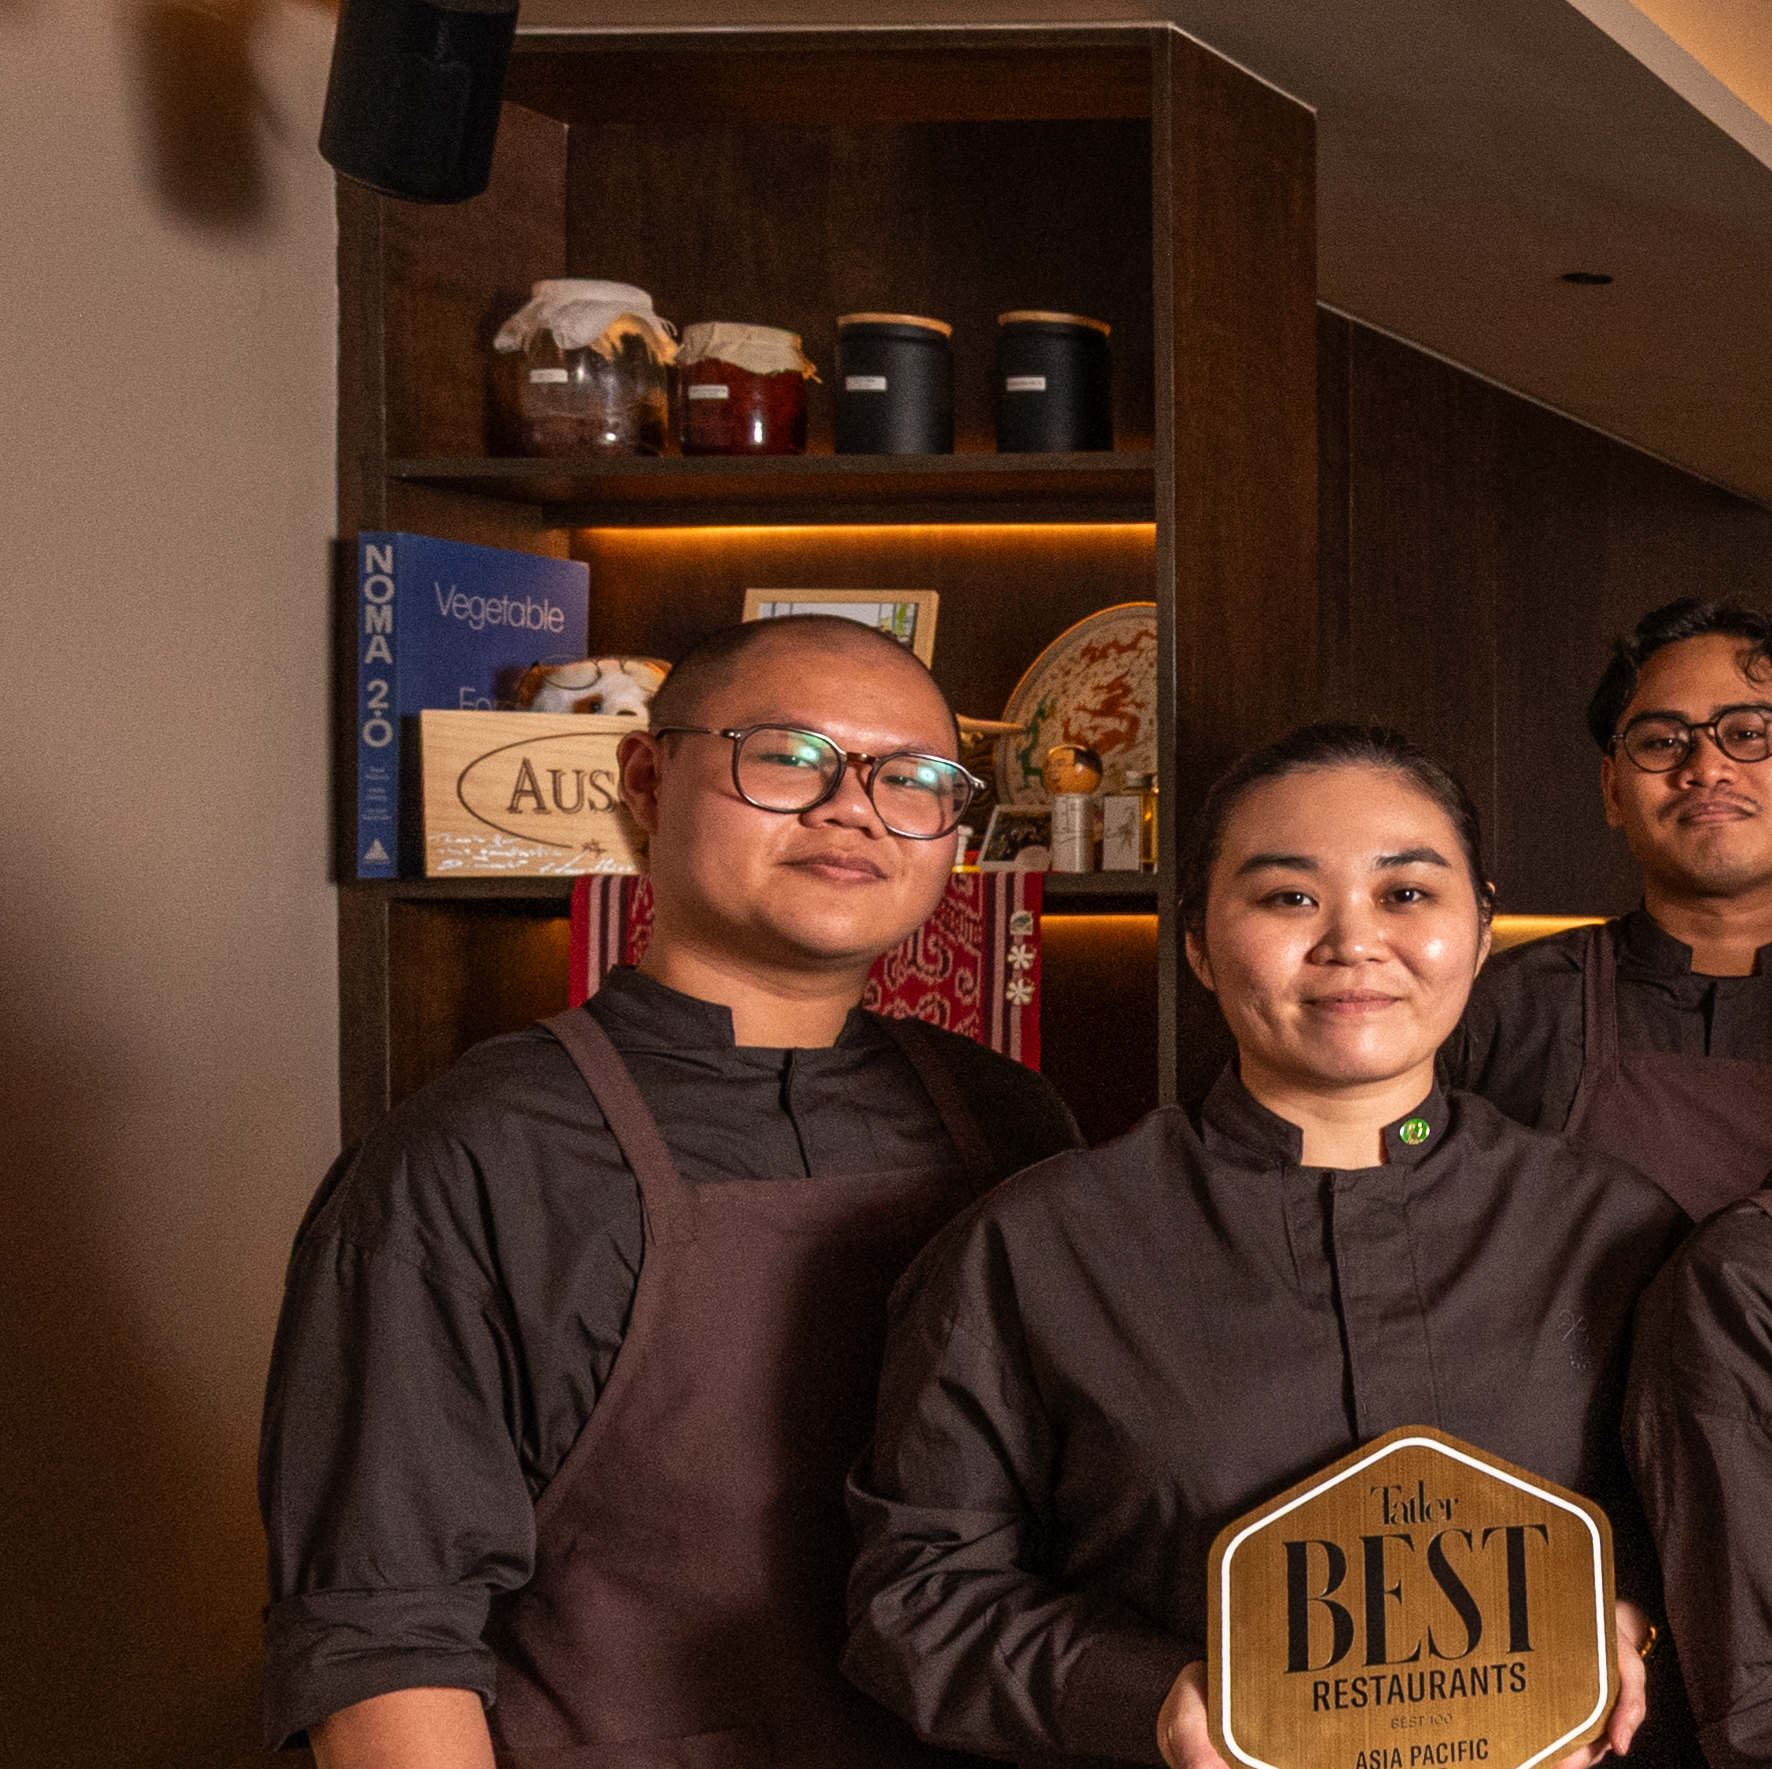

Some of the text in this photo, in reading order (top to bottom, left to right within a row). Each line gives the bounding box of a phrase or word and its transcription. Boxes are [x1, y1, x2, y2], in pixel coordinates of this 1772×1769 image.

[363, 543, 396, 665] NOMA
[434, 580, 566, 634] Vegetable
[1370, 1481, 1459, 1525] Tatler
[1281, 1523, 1549, 1674] BEST
[1312, 1662, 1527, 1712] RESTAURANTS
[1390, 1715, 1425, 1730] BEST
[1410, 1737, 1489, 1768] PACIFIC
